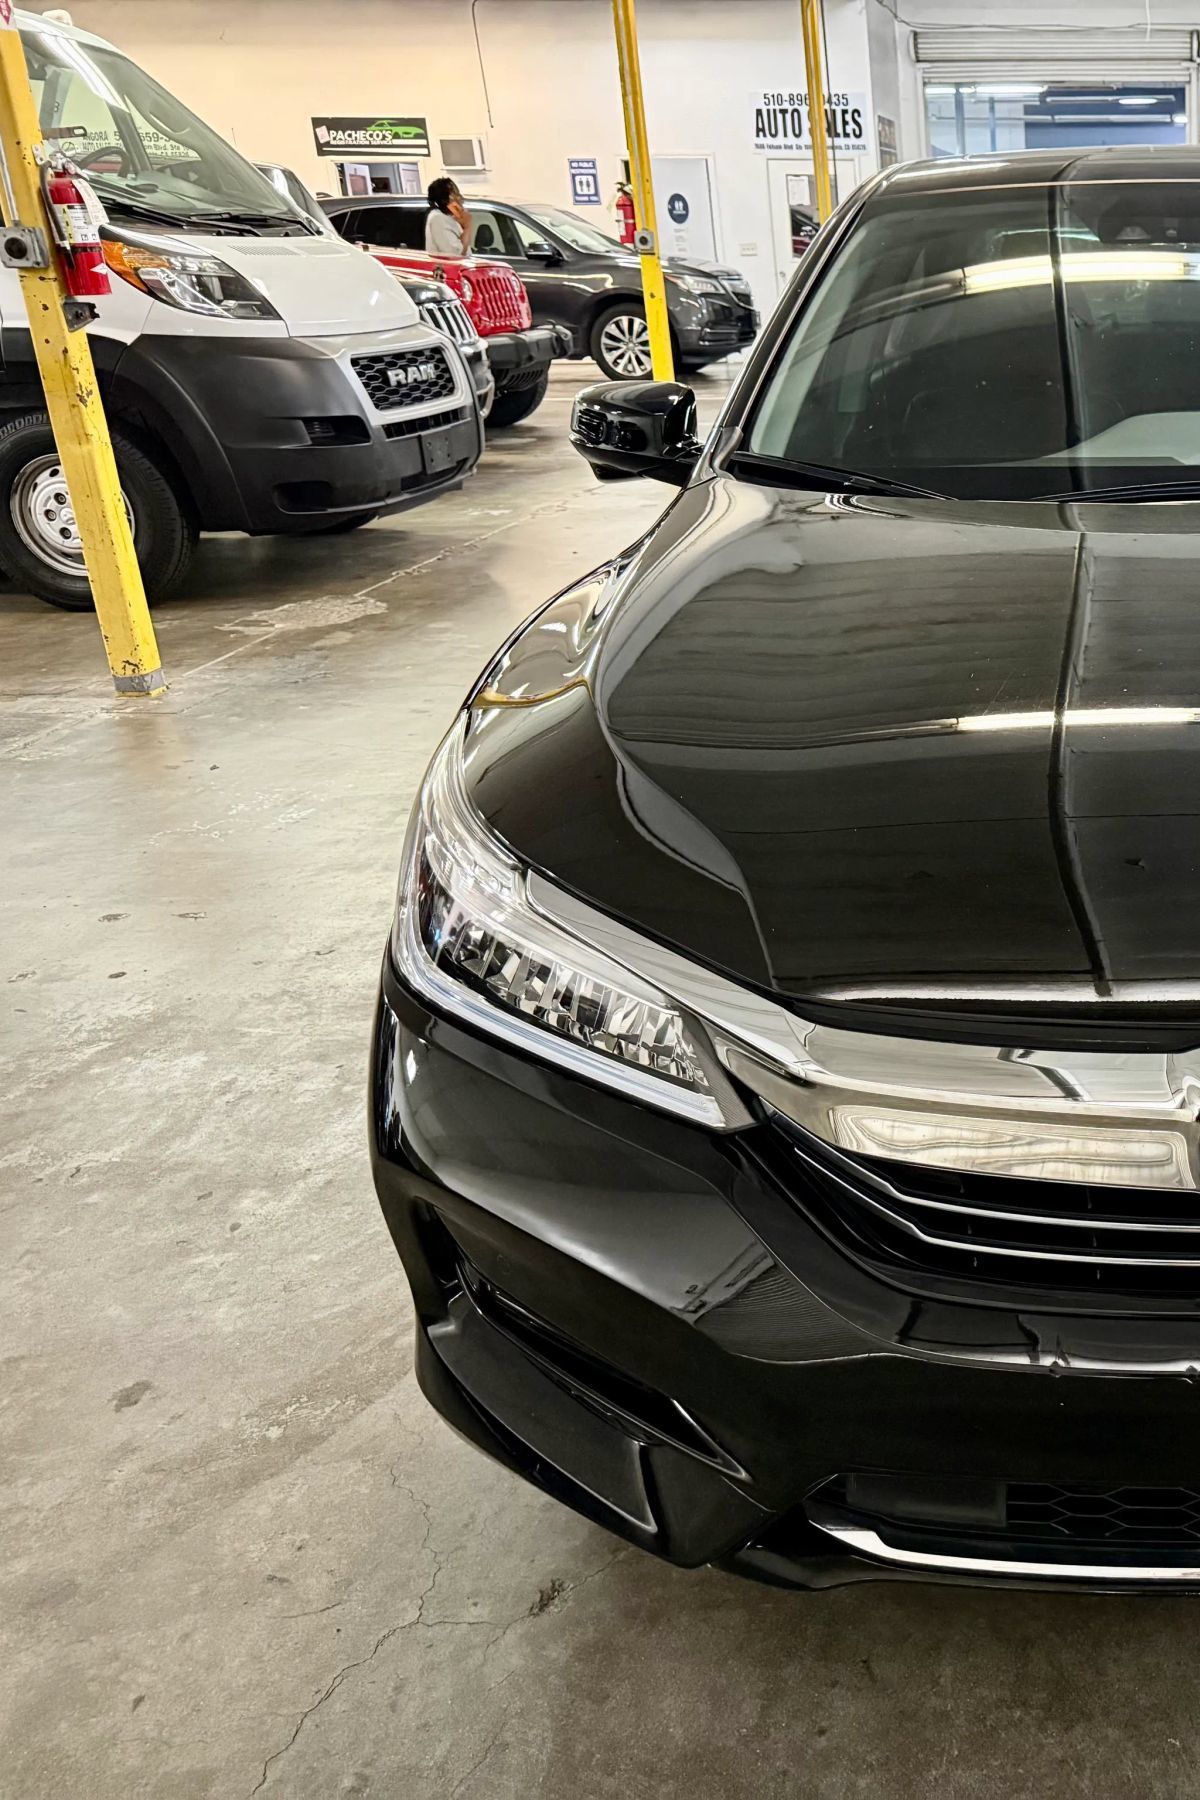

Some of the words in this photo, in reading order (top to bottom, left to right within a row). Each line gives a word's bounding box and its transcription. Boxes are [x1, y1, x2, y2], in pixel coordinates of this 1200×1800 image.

[755, 108, 802, 138] AUTO
[808, 108, 863, 138] ALES
[329, 130, 393, 141] PACHECO'S
[387, 363, 436, 387] RAM
